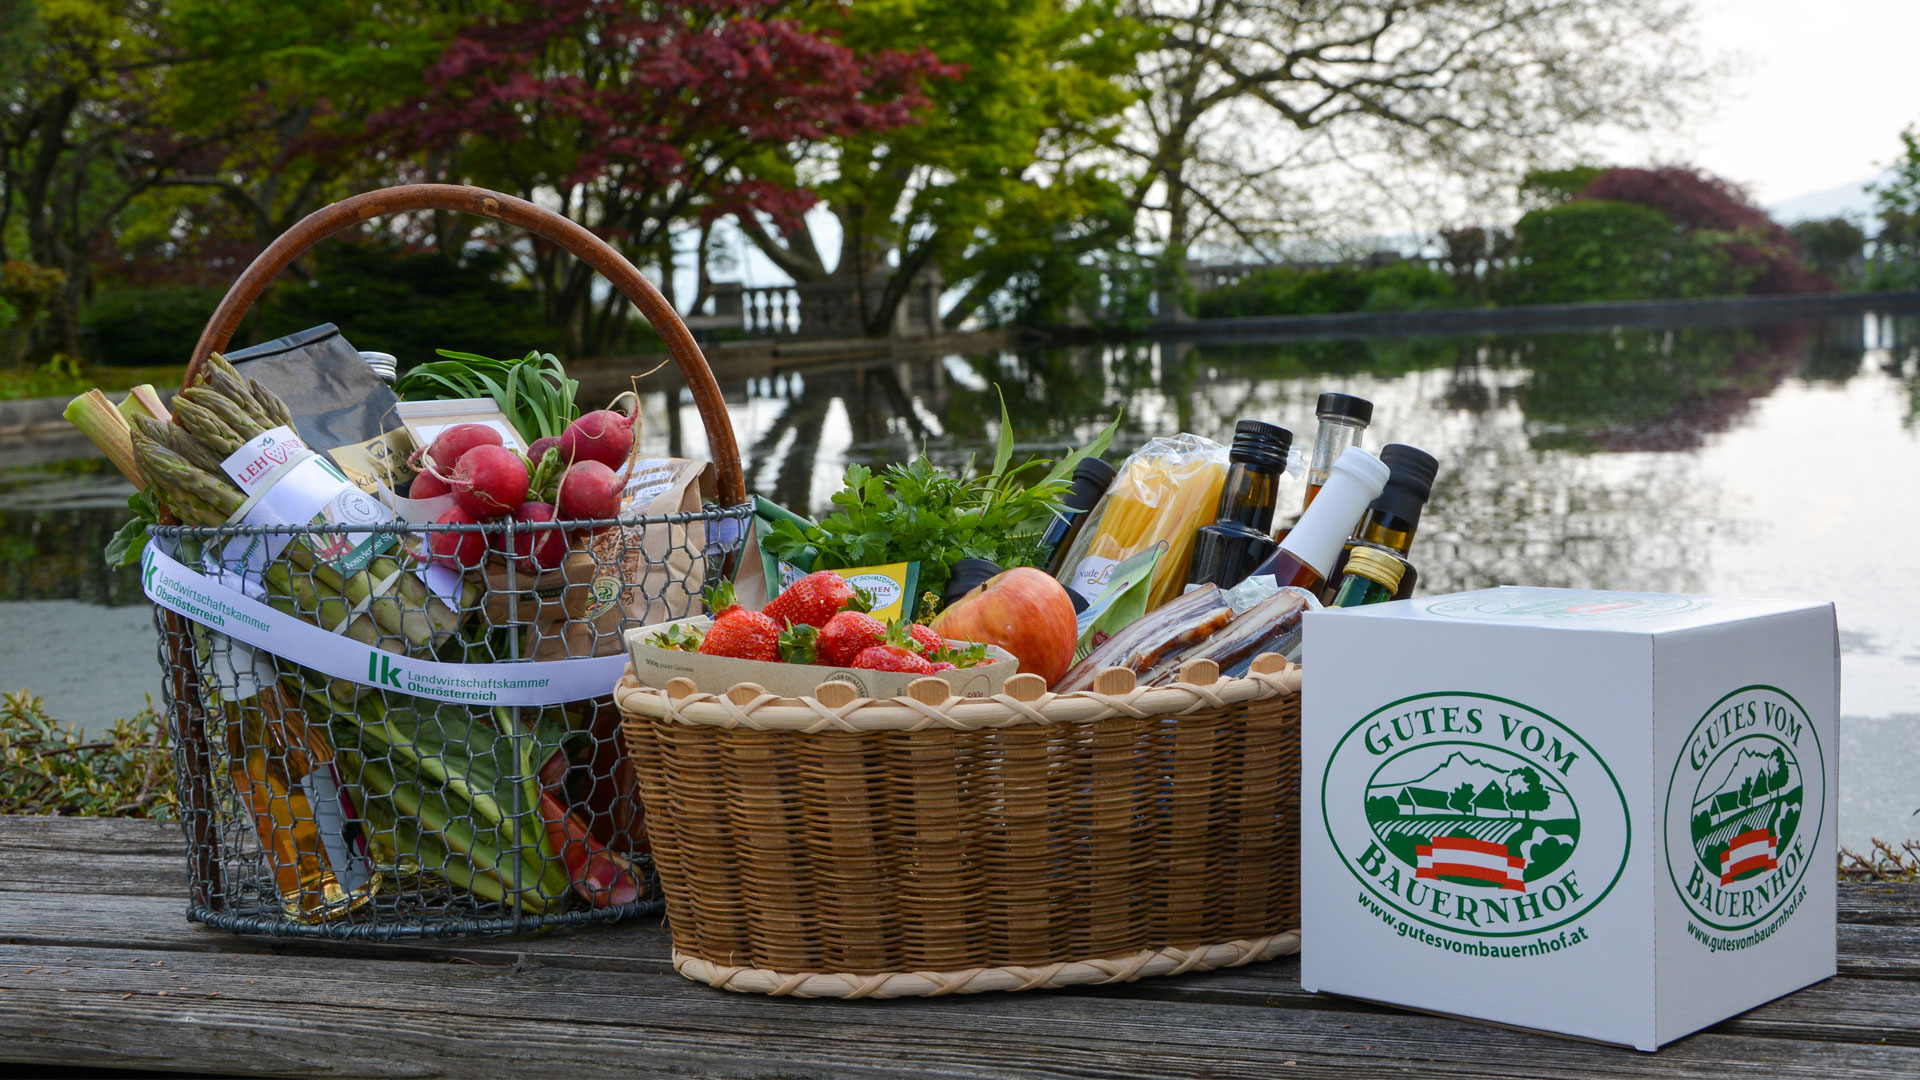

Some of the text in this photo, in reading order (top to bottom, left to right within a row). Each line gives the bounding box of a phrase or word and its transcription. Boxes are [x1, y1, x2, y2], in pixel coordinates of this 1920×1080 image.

[155, 585, 225, 627] Oberösterreich
[159, 571, 271, 633] Landwirtschaftskammer
[407, 682, 497, 701] Oberösterreich
[408, 670, 550, 689] Landwirtschaftskammer
[1364, 706, 1580, 777] GUTES VOM
[1690, 700, 1803, 771] GUTES VOM
[1355, 838, 1584, 928] BAUERNHOF
[1685, 833, 1805, 918] BAUERNHOF
[1357, 891, 1589, 958] www.gutesvombauernhof.at
[1687, 884, 1807, 953] www.gutesvombauernhof.at
